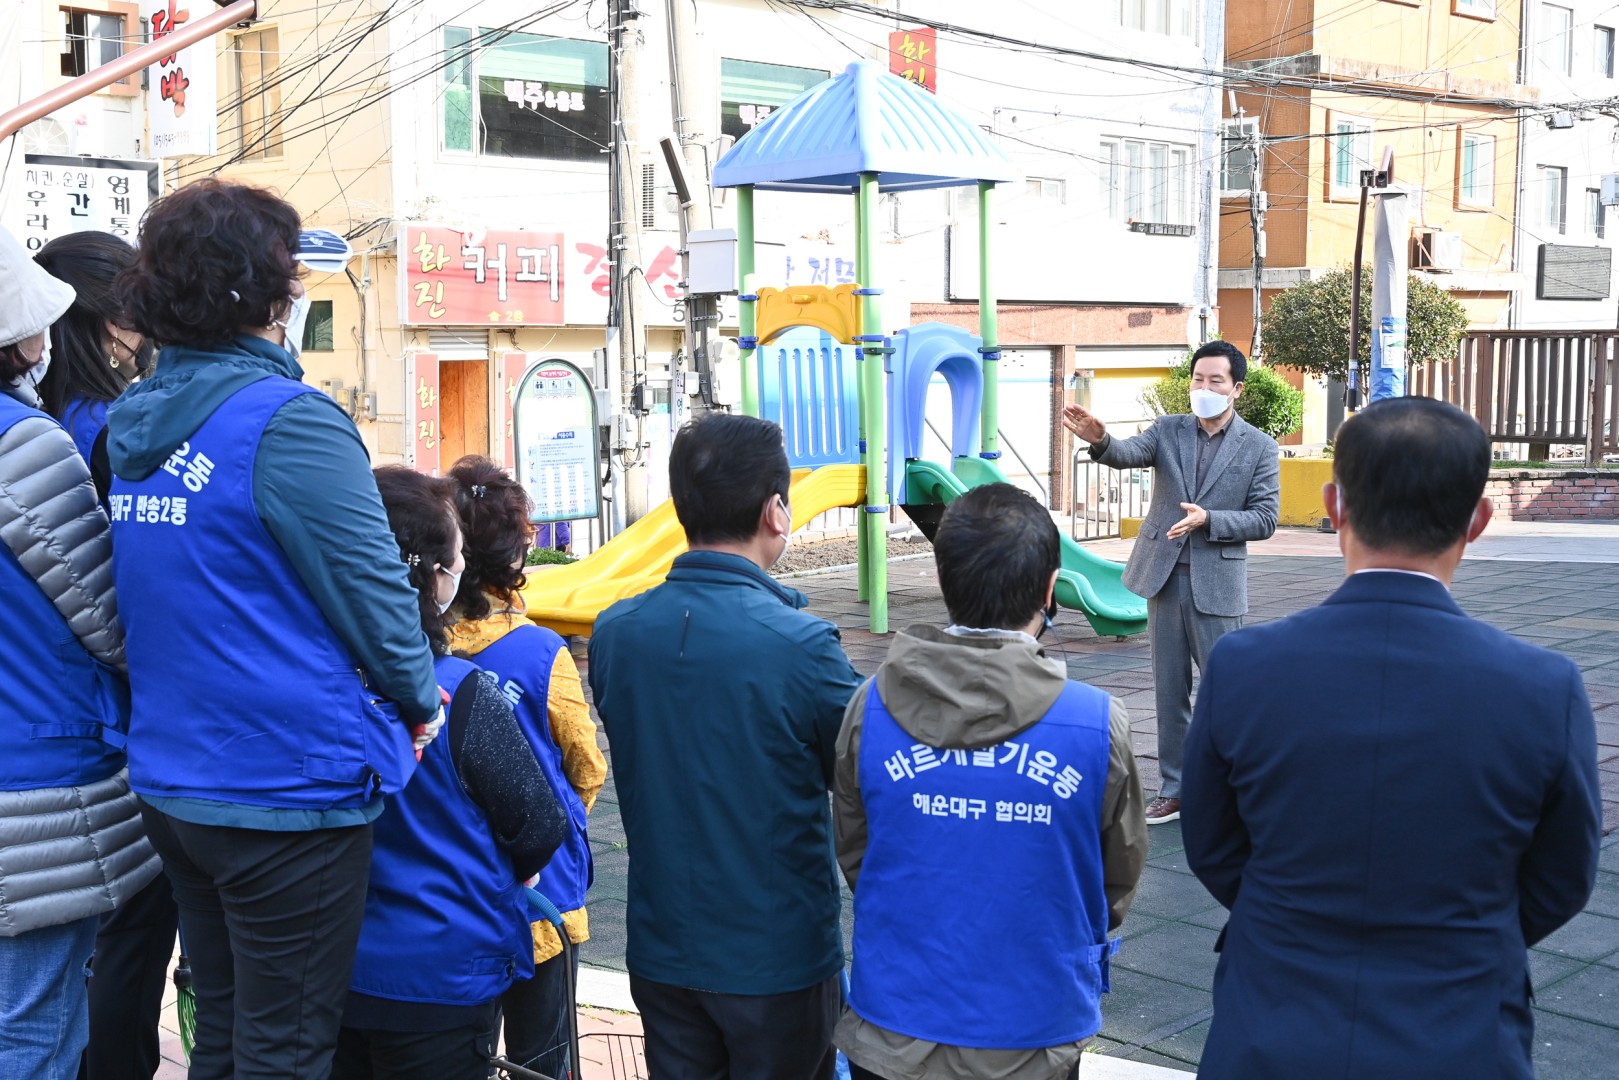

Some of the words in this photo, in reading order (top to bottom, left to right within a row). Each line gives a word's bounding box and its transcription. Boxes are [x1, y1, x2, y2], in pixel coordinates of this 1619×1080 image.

[413, 231, 451, 319] 화진
[461, 243, 560, 303] 커피
[416, 377, 437, 449] 화진
[136, 495, 187, 526] 반송2동
[912, 793, 987, 820] 해운대구
[996, 801, 1052, 825] 협의회
